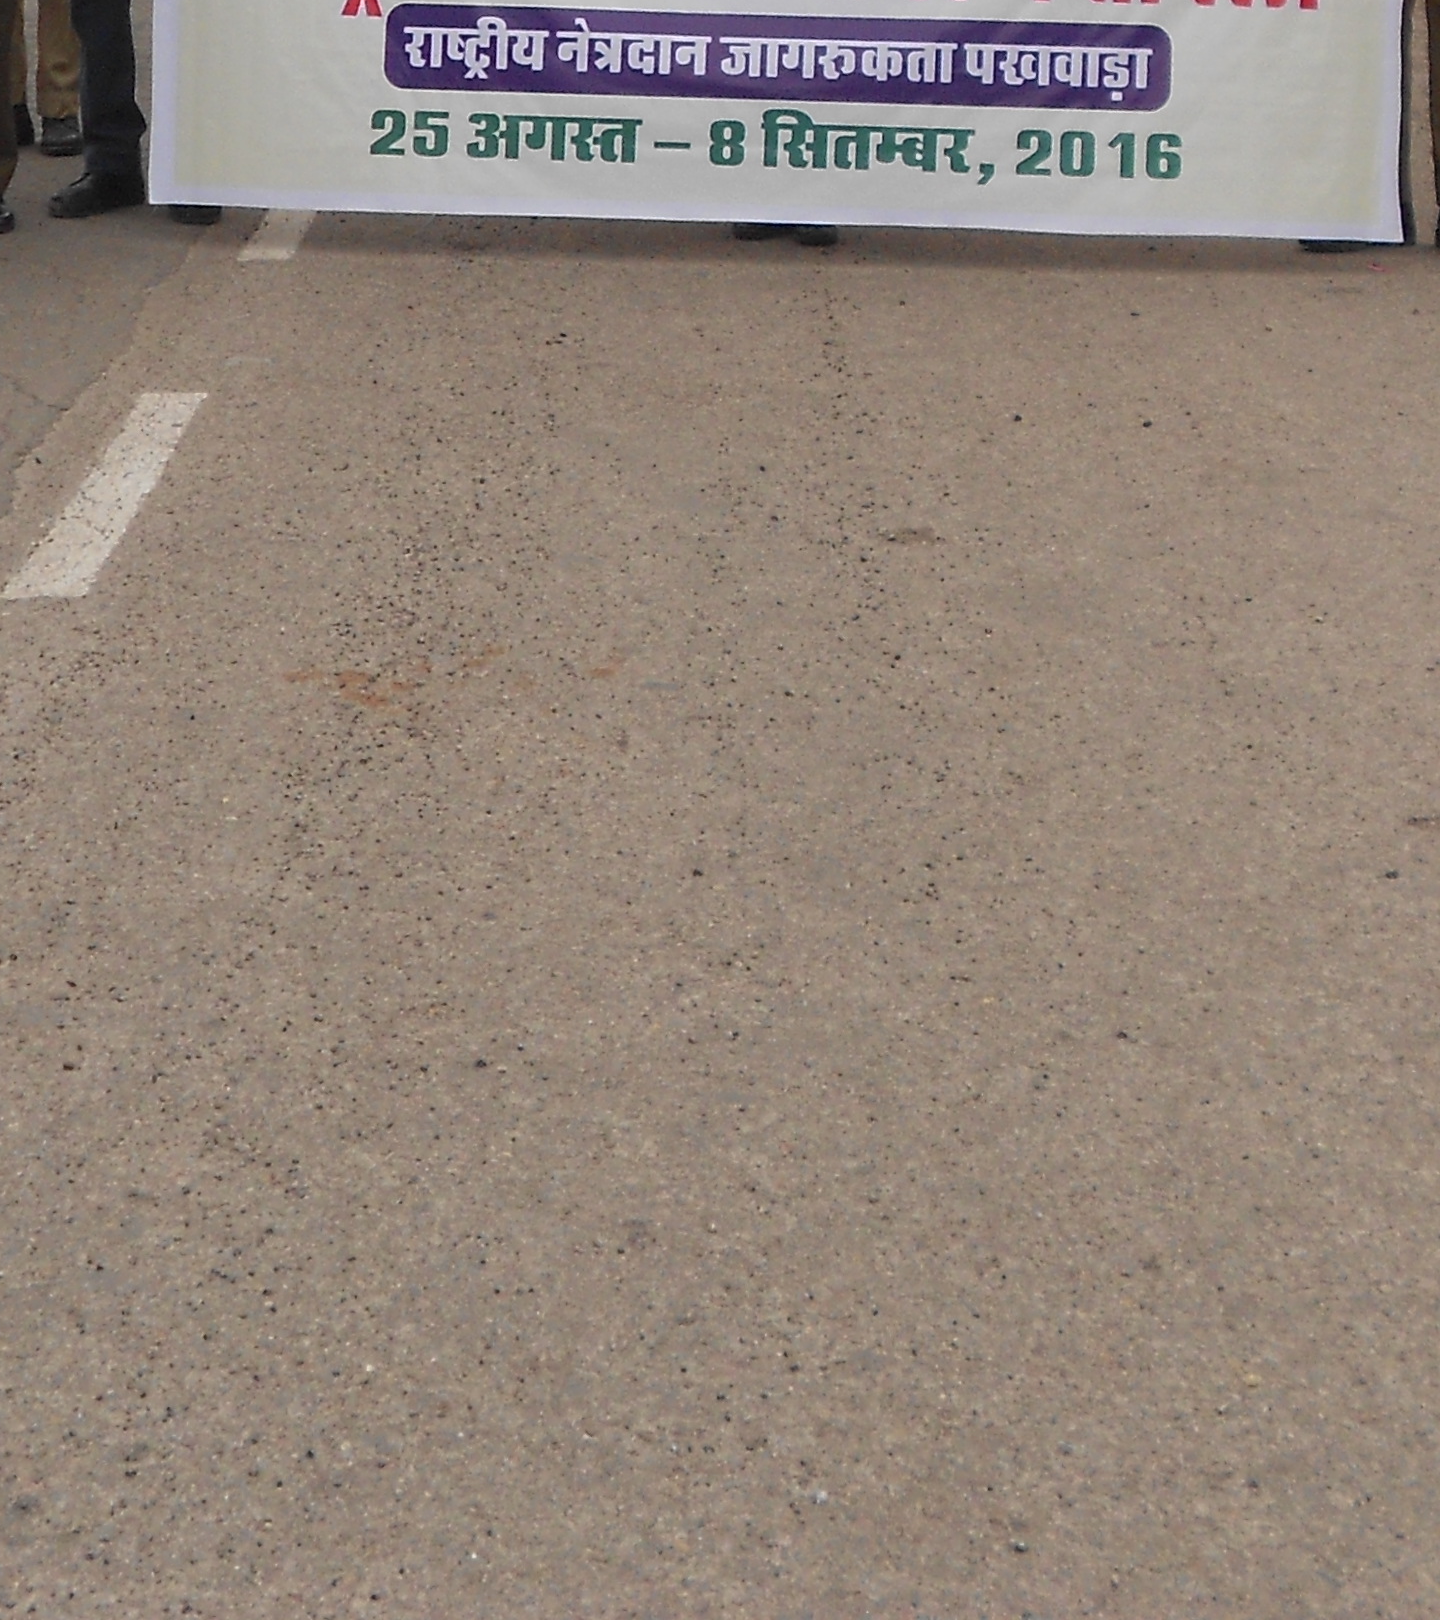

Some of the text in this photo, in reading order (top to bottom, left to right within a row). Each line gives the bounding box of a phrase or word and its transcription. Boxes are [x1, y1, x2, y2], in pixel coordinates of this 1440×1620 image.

[403, 17, 549, 80] राष्ट्रीय
[556, 18, 711, 77] नेत्रदान
[965, 43, 1153, 102] पखवाड़ा
[370, 109, 450, 158] 25
[466, 112, 643, 165] अगस्त
[709, 119, 746, 167] 8
[761, 108, 995, 186] सितम्बर,
[1015, 129, 1185, 181] 2016
